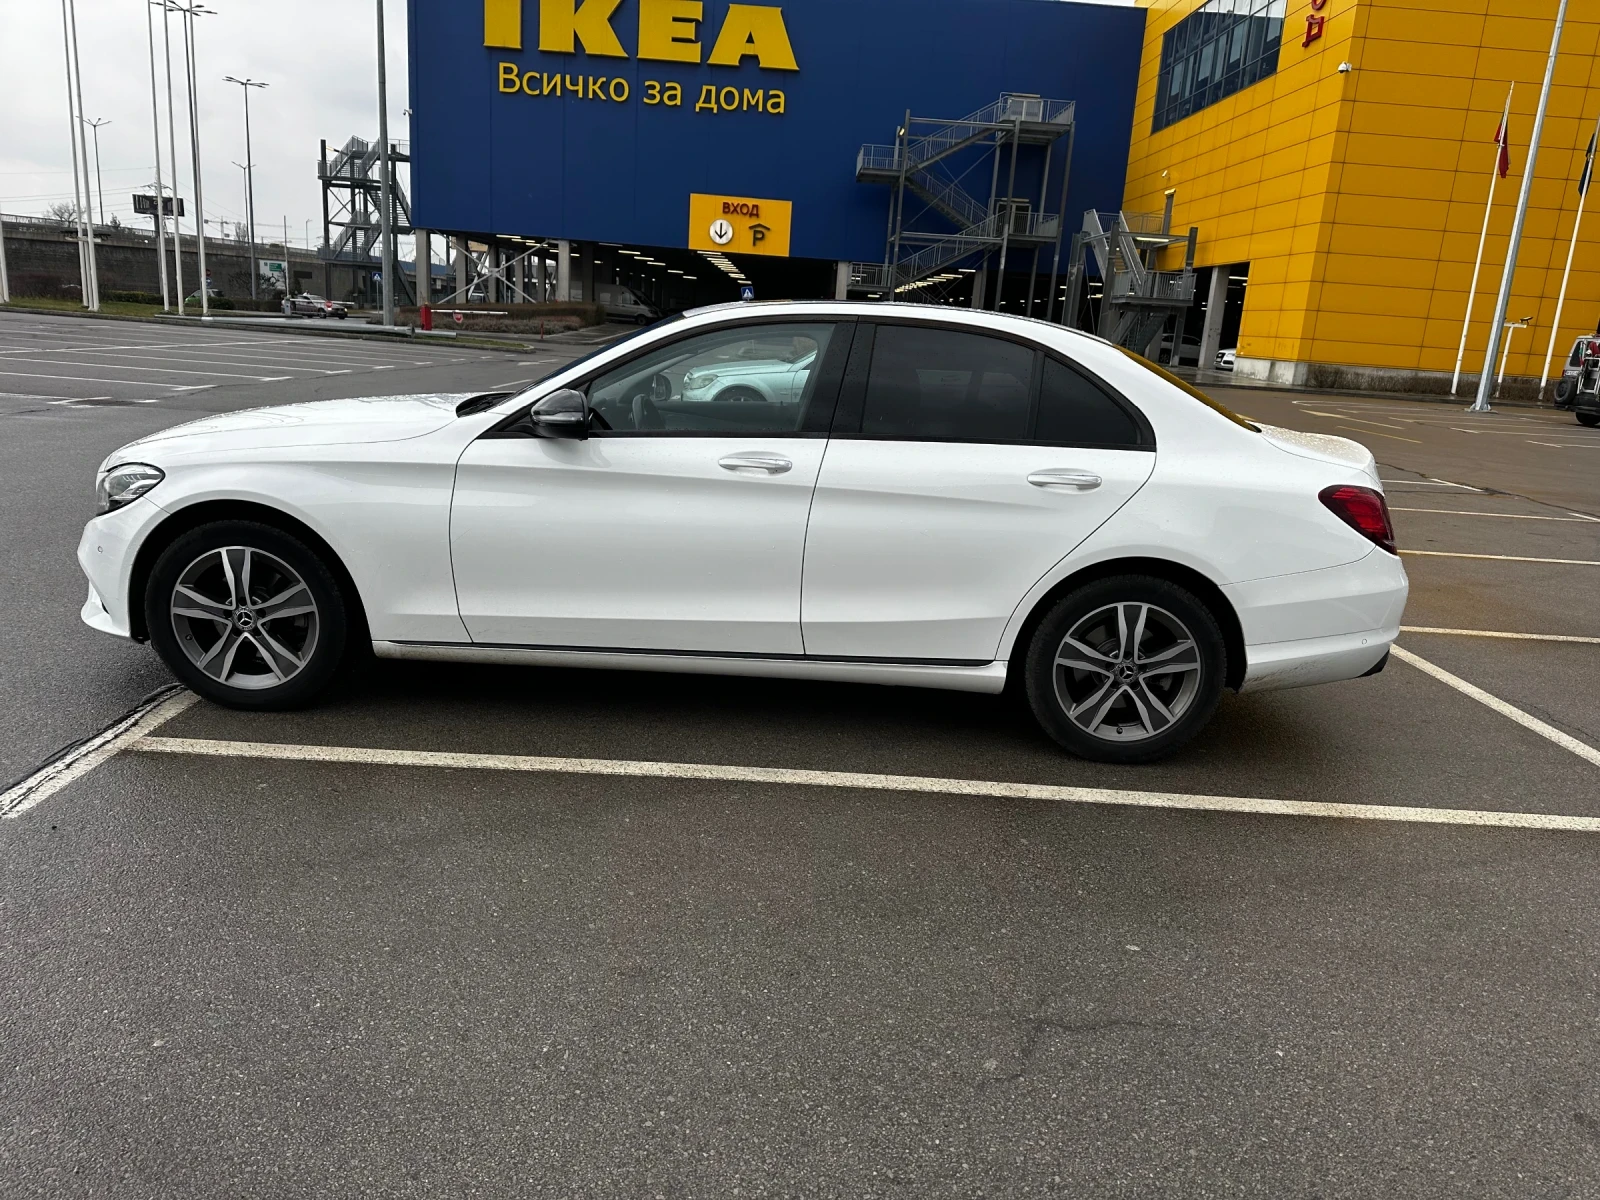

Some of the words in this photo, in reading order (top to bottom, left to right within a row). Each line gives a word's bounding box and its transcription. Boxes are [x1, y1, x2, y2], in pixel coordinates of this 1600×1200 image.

[483, 0, 800, 71] IKEA
[498, 61, 630, 102] Всичко
[643, 79, 682, 106] за
[695, 84, 786, 114] дома
[722, 201, 760, 218] ВХОД
